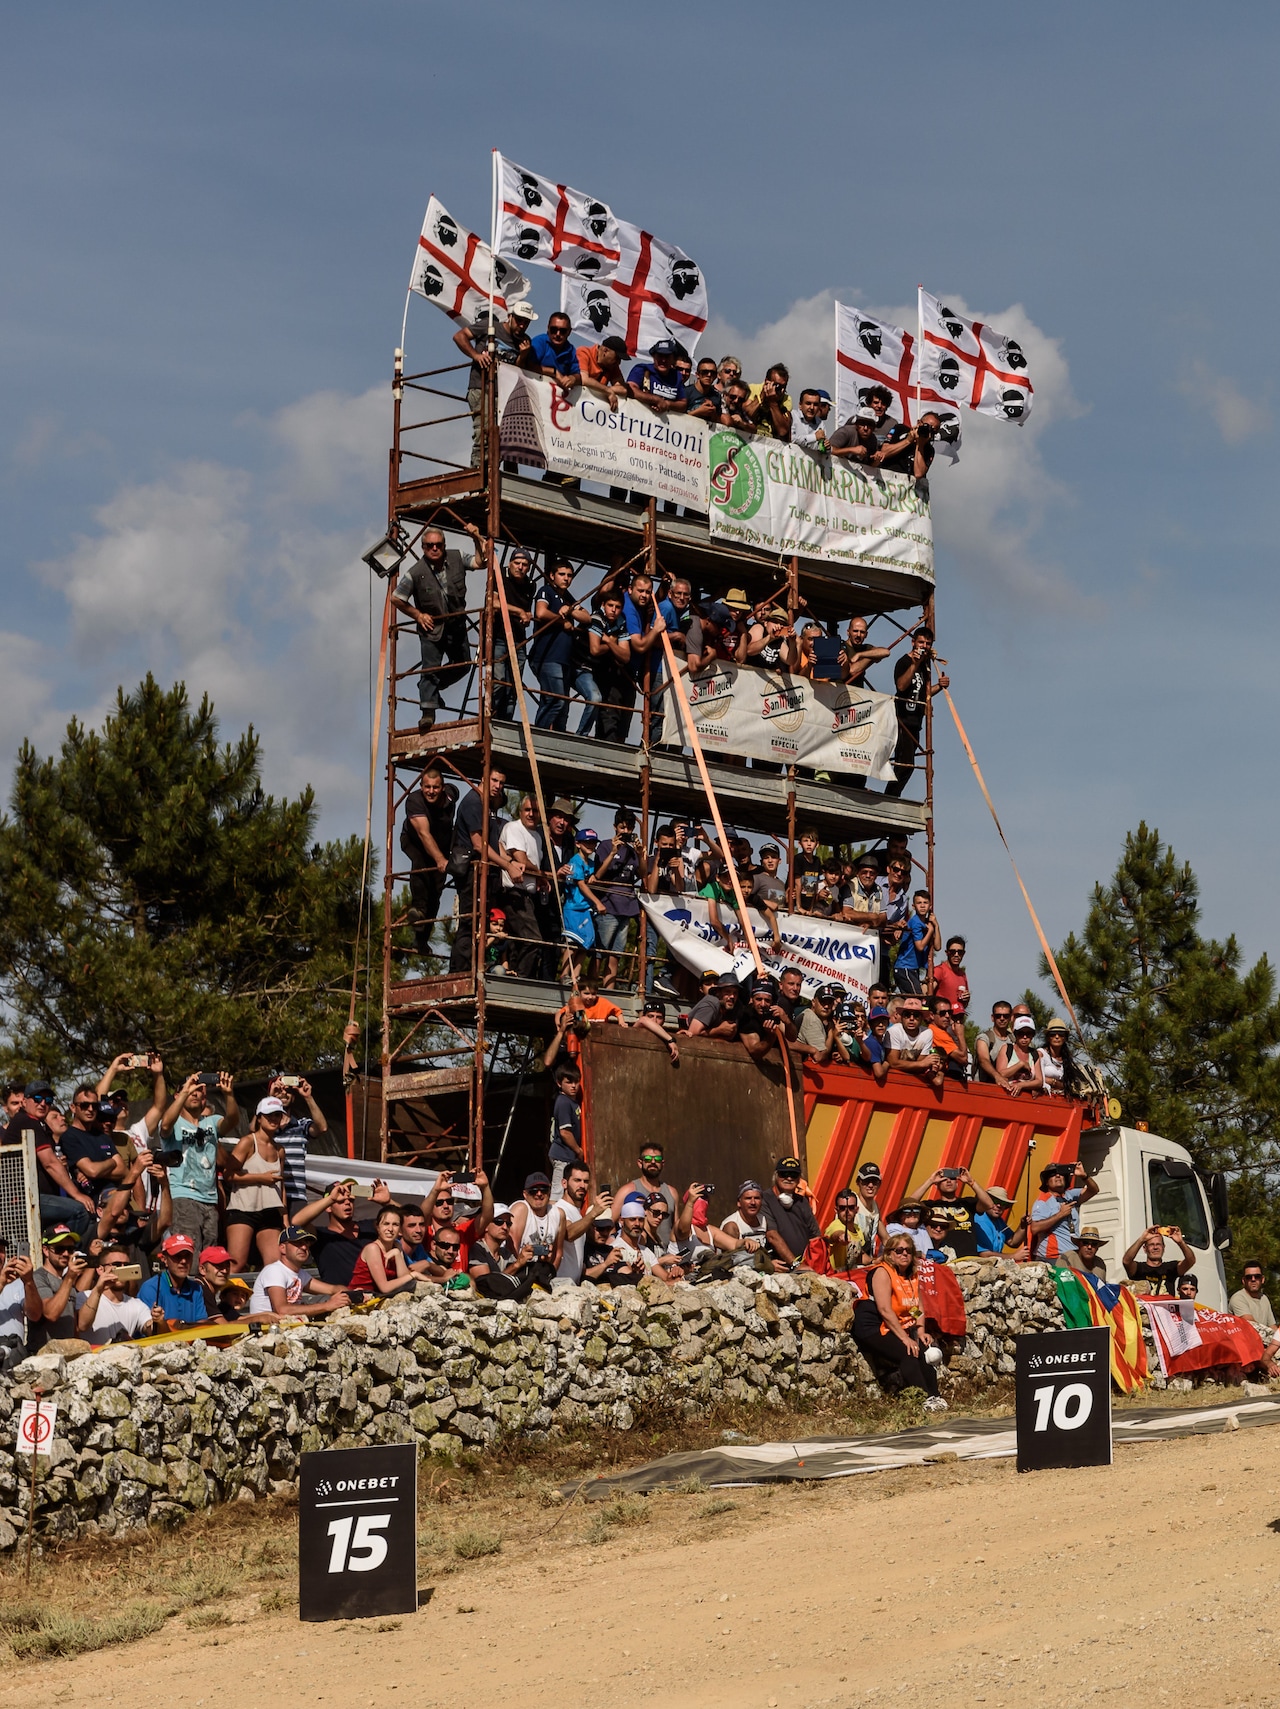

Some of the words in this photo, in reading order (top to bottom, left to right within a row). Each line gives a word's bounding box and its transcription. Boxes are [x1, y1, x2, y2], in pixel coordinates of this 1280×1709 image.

[580, 400, 703, 454] Costruzioni
[551, 436, 565, 449] Via
[577, 443, 598, 457] Segni
[627, 438, 637, 449] Di
[639, 441, 677, 461] Barracca
[679, 454, 702, 469] Carlo
[629, 456, 653, 471] 07016
[659, 464, 686, 483] Pattada
[789, 505, 812, 523] Tutto
[815, 515, 829, 528] per
[832, 517, 839, 530] il
[841, 519, 858, 534] Bar
[861, 527, 866, 535] e
[870, 524, 881, 535] la
[696, 727, 728, 737] ESPECIAL
[771, 740, 798, 750] ESPECIAL
[840, 752, 871, 761] ESPECIAL
[797, 957, 846, 983] PIATTAFORME
[848, 976, 859, 989] PER
[1045, 1352, 1096, 1365] ONEBET
[1033, 1383, 1093, 1432] 10
[336, 1476, 399, 1491] ONEBET
[327, 1514, 391, 1573] 15
